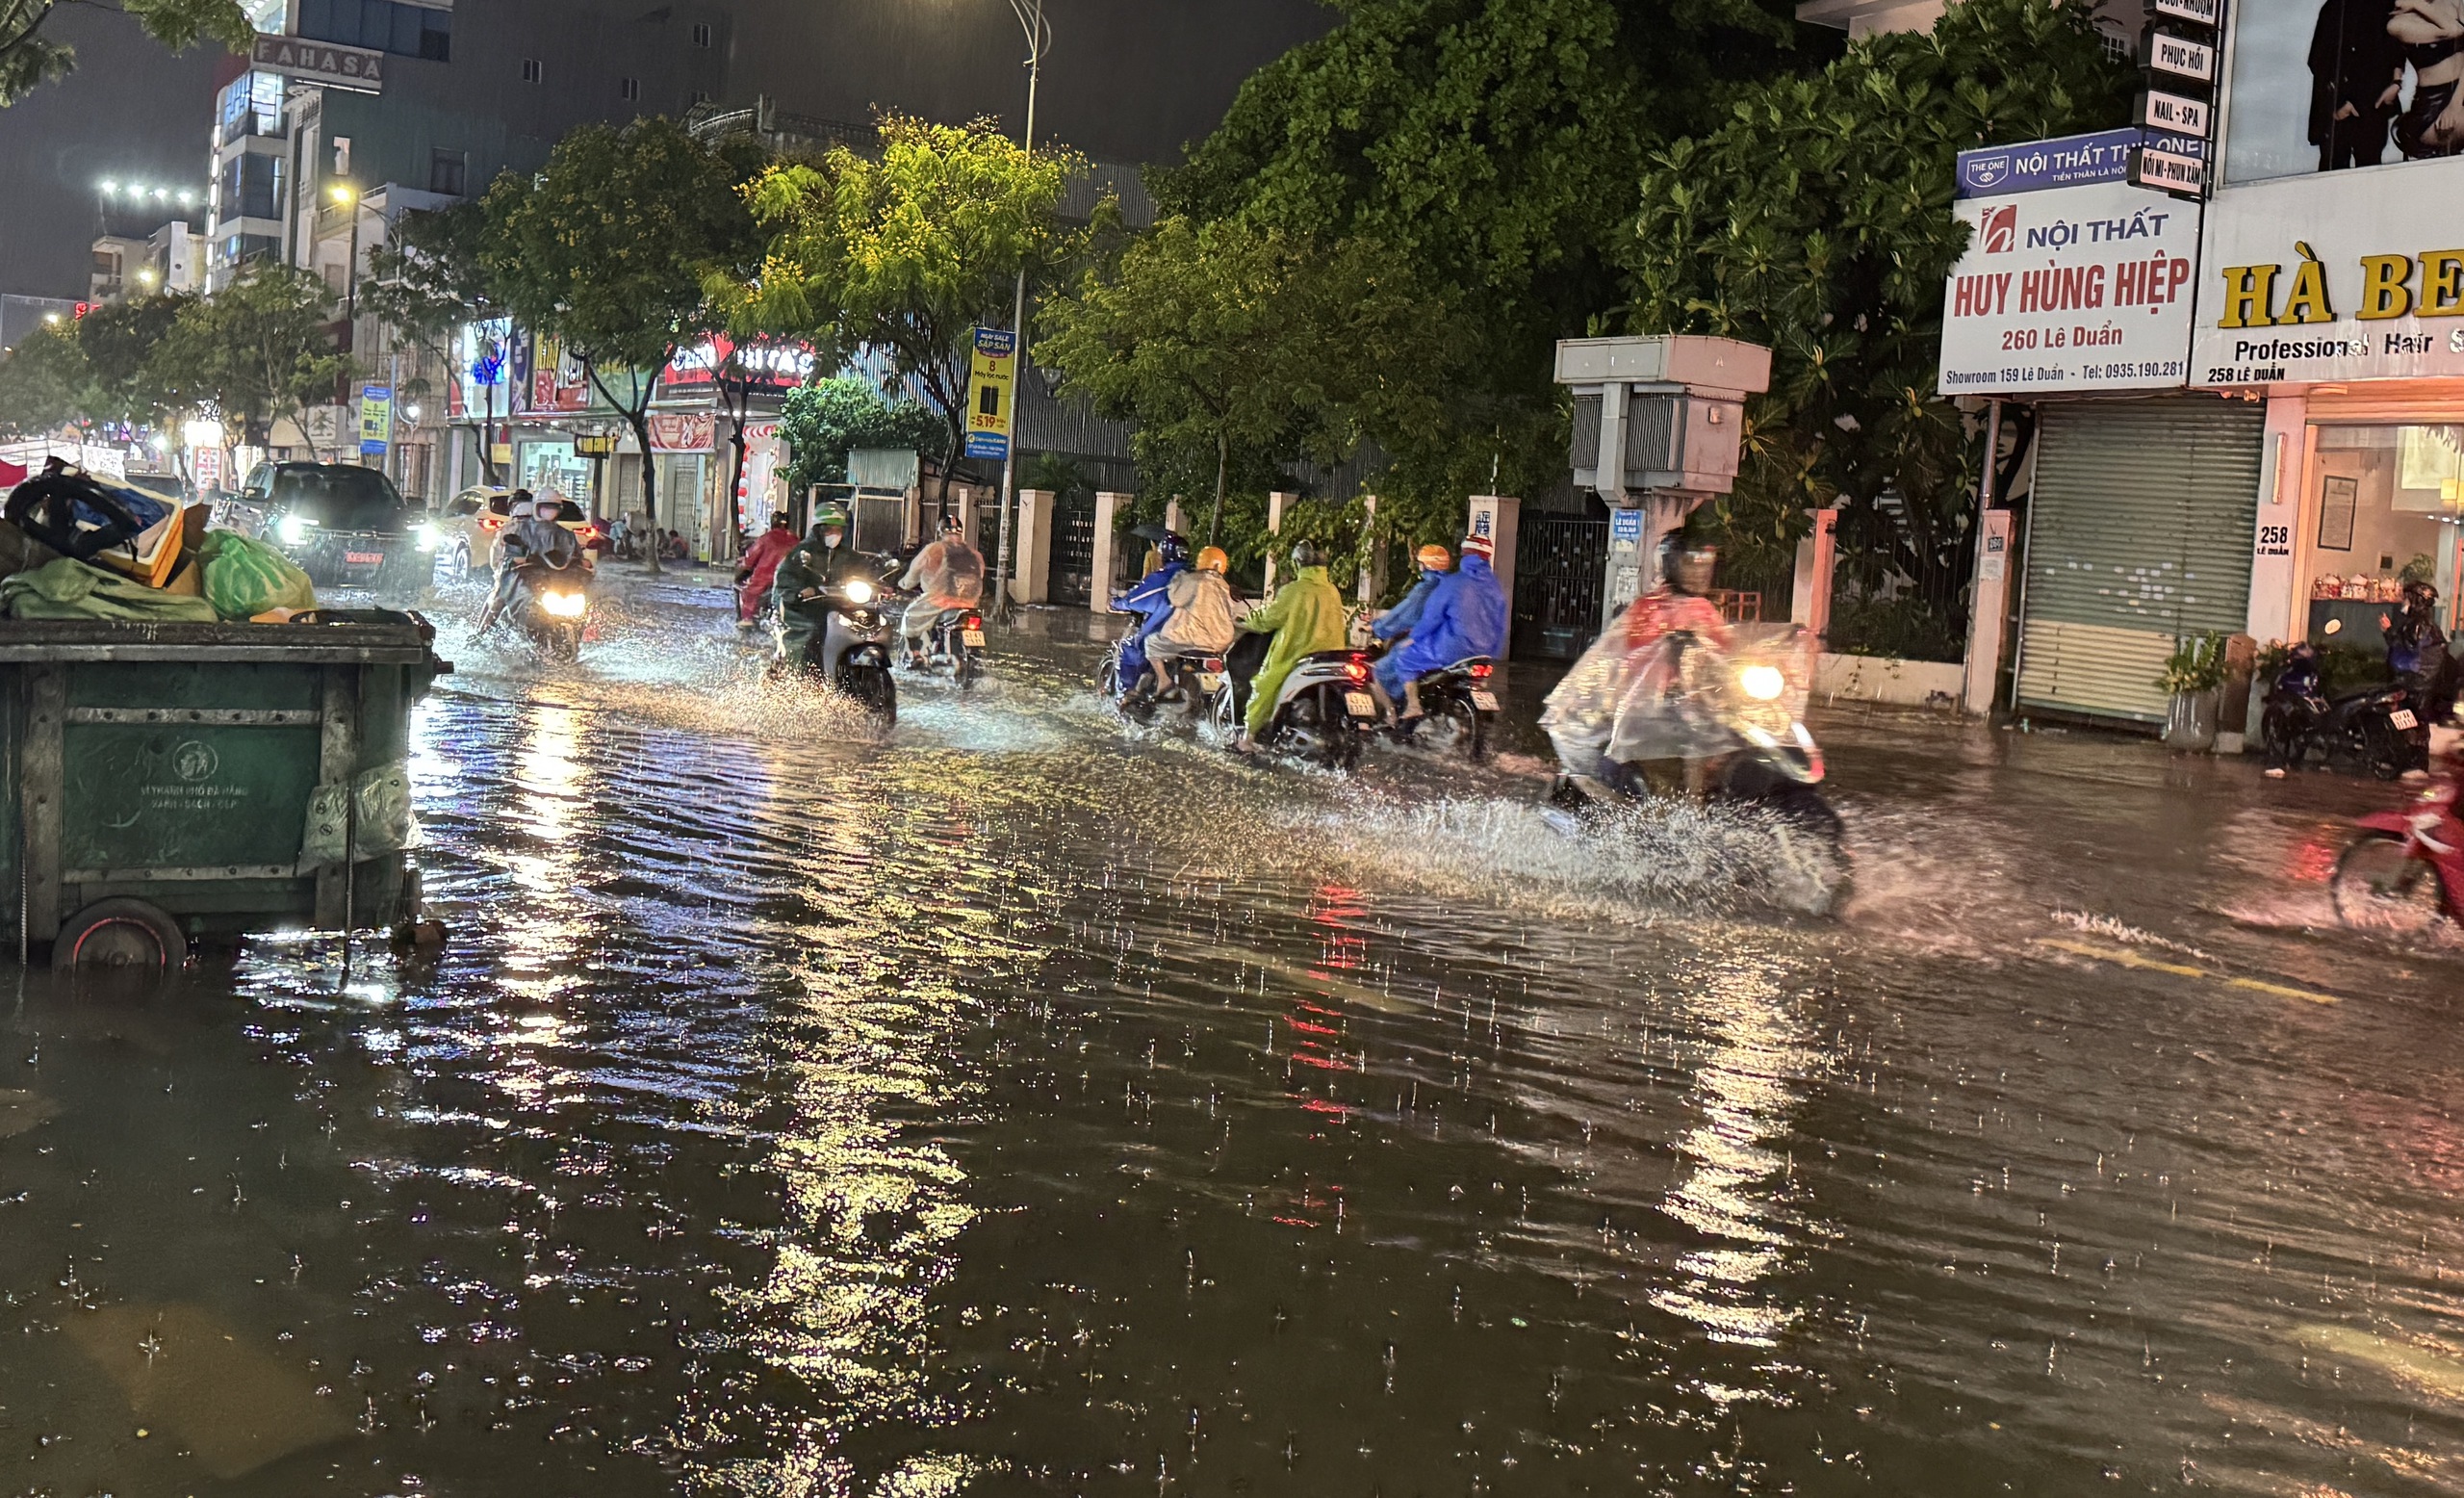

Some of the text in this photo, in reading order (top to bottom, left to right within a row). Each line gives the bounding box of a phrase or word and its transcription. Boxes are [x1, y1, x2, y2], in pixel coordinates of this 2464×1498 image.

[257, 40, 381, 79] FAHASA
[2161, 43, 2187, 69] PHỤC
[2154, 99, 2173, 122] NAIL
[2181, 106, 2199, 128] SPA
[1970, 160, 2006, 173] THE ONE
[2015, 151, 2048, 176] NỘI
[2053, 142, 2105, 170] THẤT
[2156, 137, 2200, 154] ONE
[2026, 206, 2169, 251] NỘI THẤT
[1954, 248, 2190, 318] HUY HÙNG HIỆP
[2217, 240, 2339, 329] HÀ
[2001, 319, 2123, 350] 260 Lê Duẩn
[2234, 334, 2370, 362] Professional
[2384, 332, 2434, 355] Hair
[1945, 370, 1997, 385] Showroom
[2000, 367, 2019, 383] 159
[2022, 366, 2034, 382] Lê
[2037, 362, 2064, 381] Duẩn
[2082, 364, 2102, 379] Tel:
[2105, 361, 2184, 378] 0935.190.281
[2208, 361, 2286, 384] 258 LÊ DUẨN
[2260, 526, 2289, 545] 258
